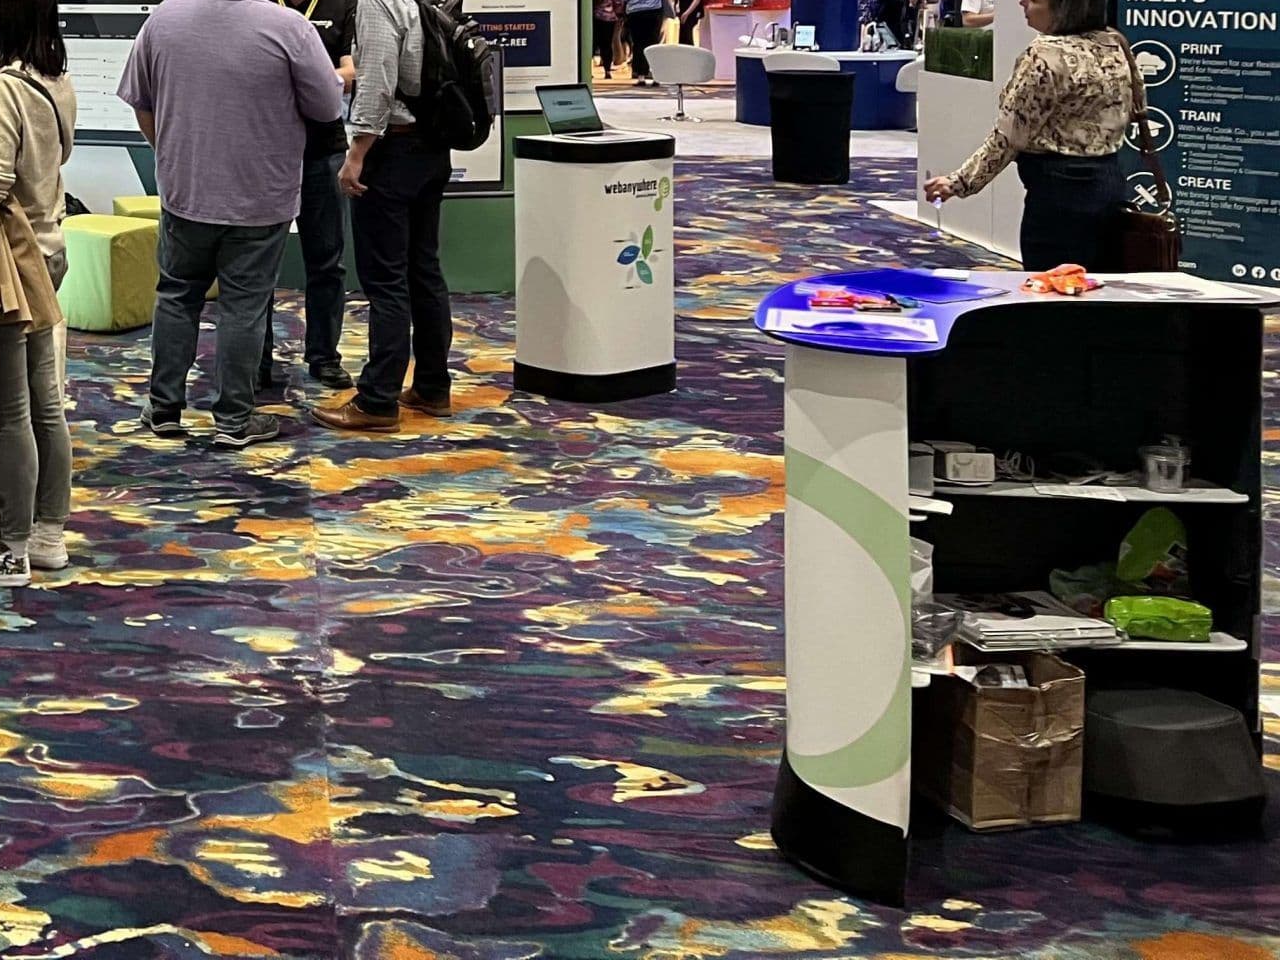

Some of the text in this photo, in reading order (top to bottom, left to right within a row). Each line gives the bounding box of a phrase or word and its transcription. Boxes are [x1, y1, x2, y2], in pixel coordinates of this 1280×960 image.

[1126, 8, 1277, 31] INNOVATION
[479, 22, 536, 32] TTING STARTED
[1181, 43, 1223, 55] PRINT
[1179, 109, 1221, 122] TRAIN
[604, 178, 657, 195] webanywhere
[1178, 175, 1233, 190] CREATE
